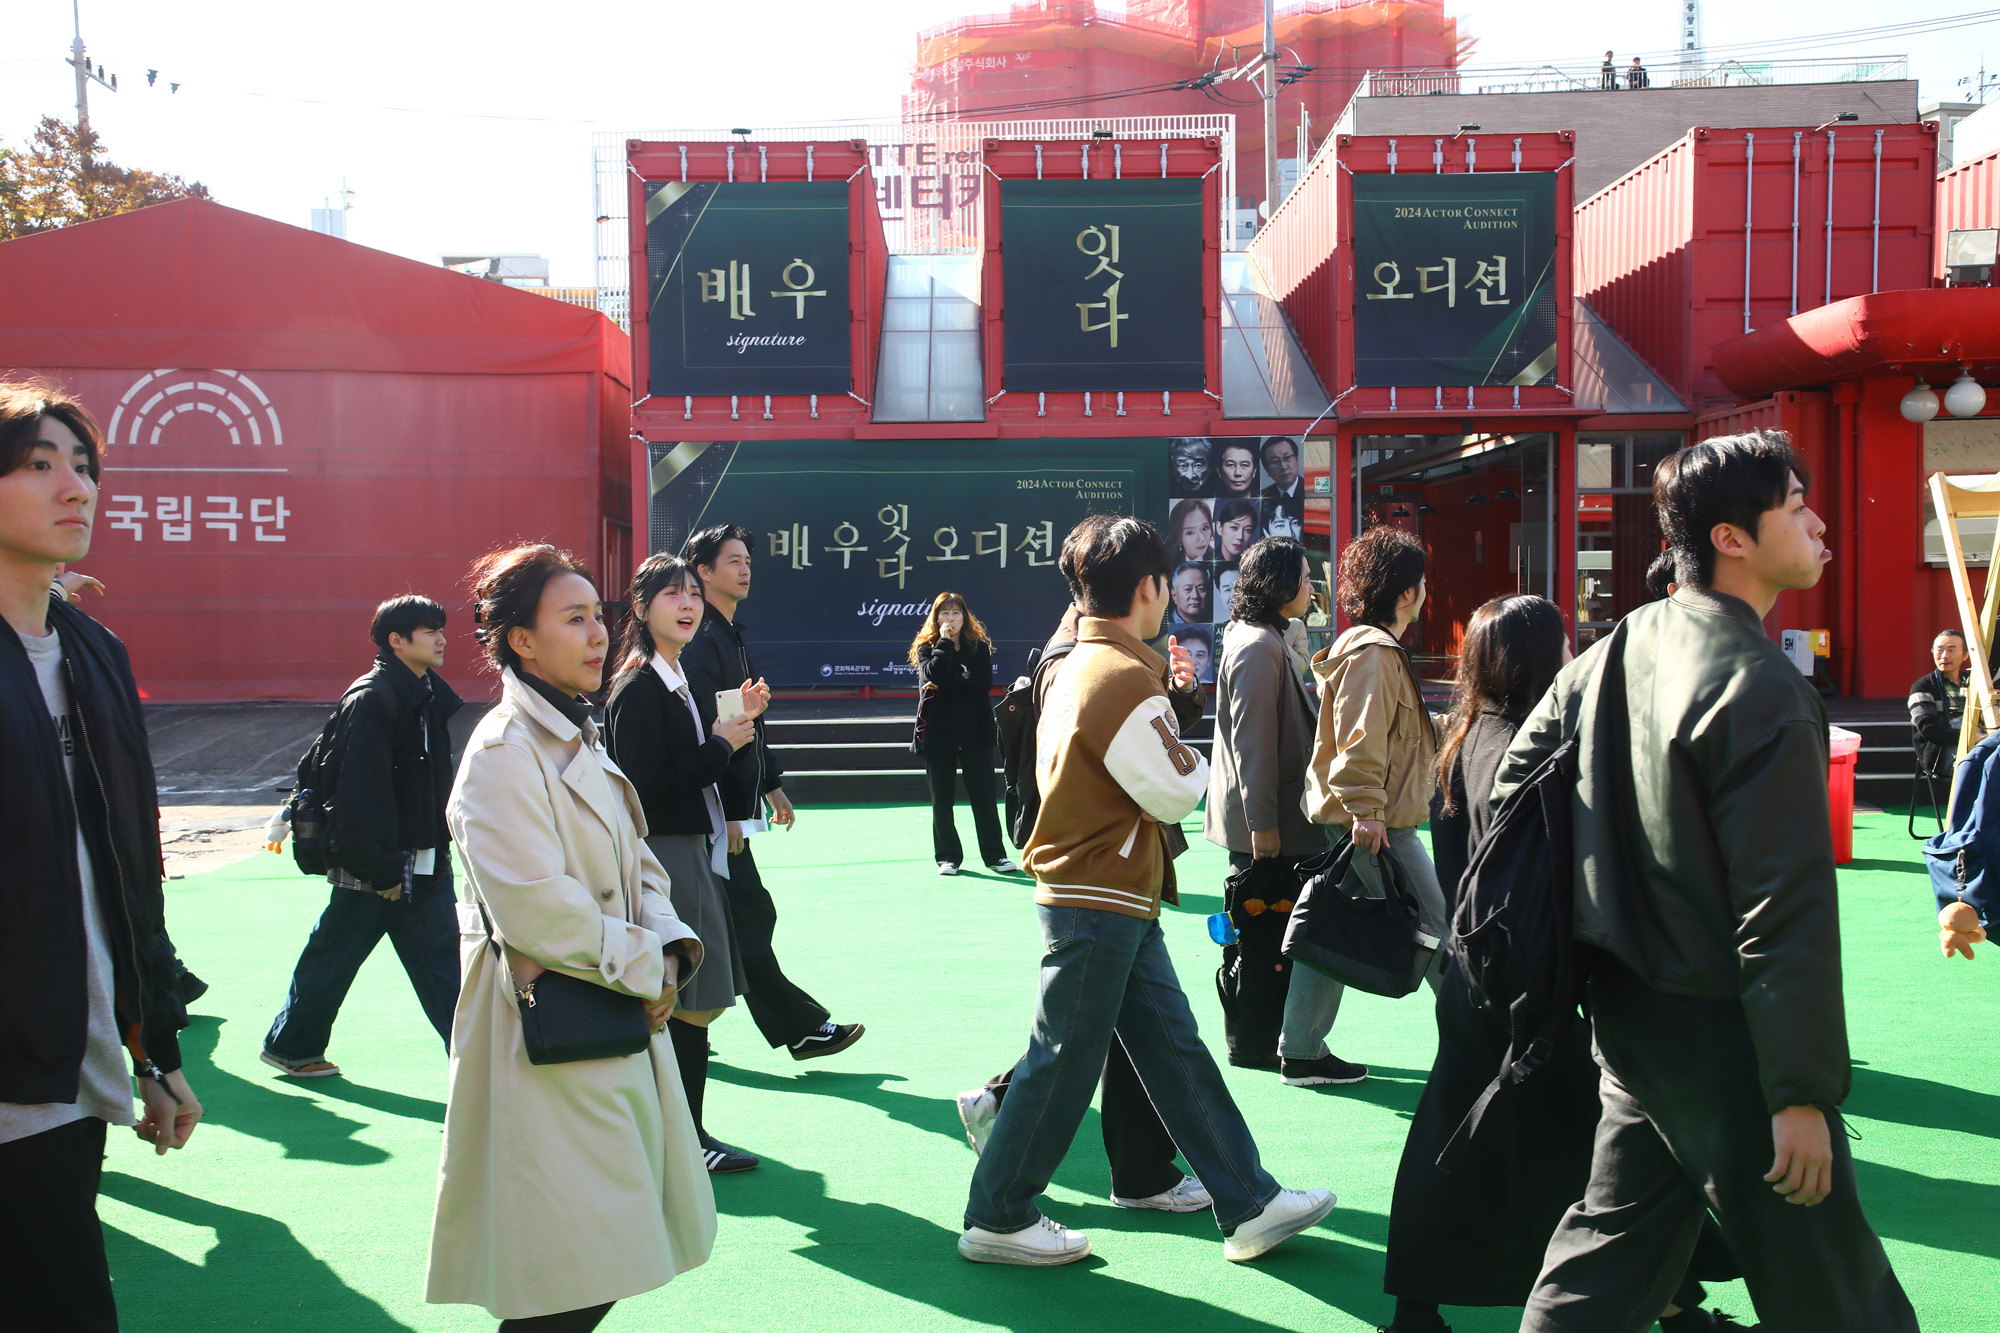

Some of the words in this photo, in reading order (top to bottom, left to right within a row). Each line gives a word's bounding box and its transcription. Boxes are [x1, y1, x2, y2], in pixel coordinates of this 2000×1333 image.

[866, 143, 936, 166] TTE
[945, 151, 982, 163] ren
[1394, 206, 1422, 218] 2024
[697, 258, 827, 321] 배우
[1366, 254, 1511, 308] 오디션
[726, 331, 807, 354] signature
[1016, 480, 1040, 489] 2024
[105, 494, 291, 542] 국립극단
[767, 521, 868, 570] 배우
[926, 520, 1056, 569] 오디션
[857, 598, 932, 627] signat
